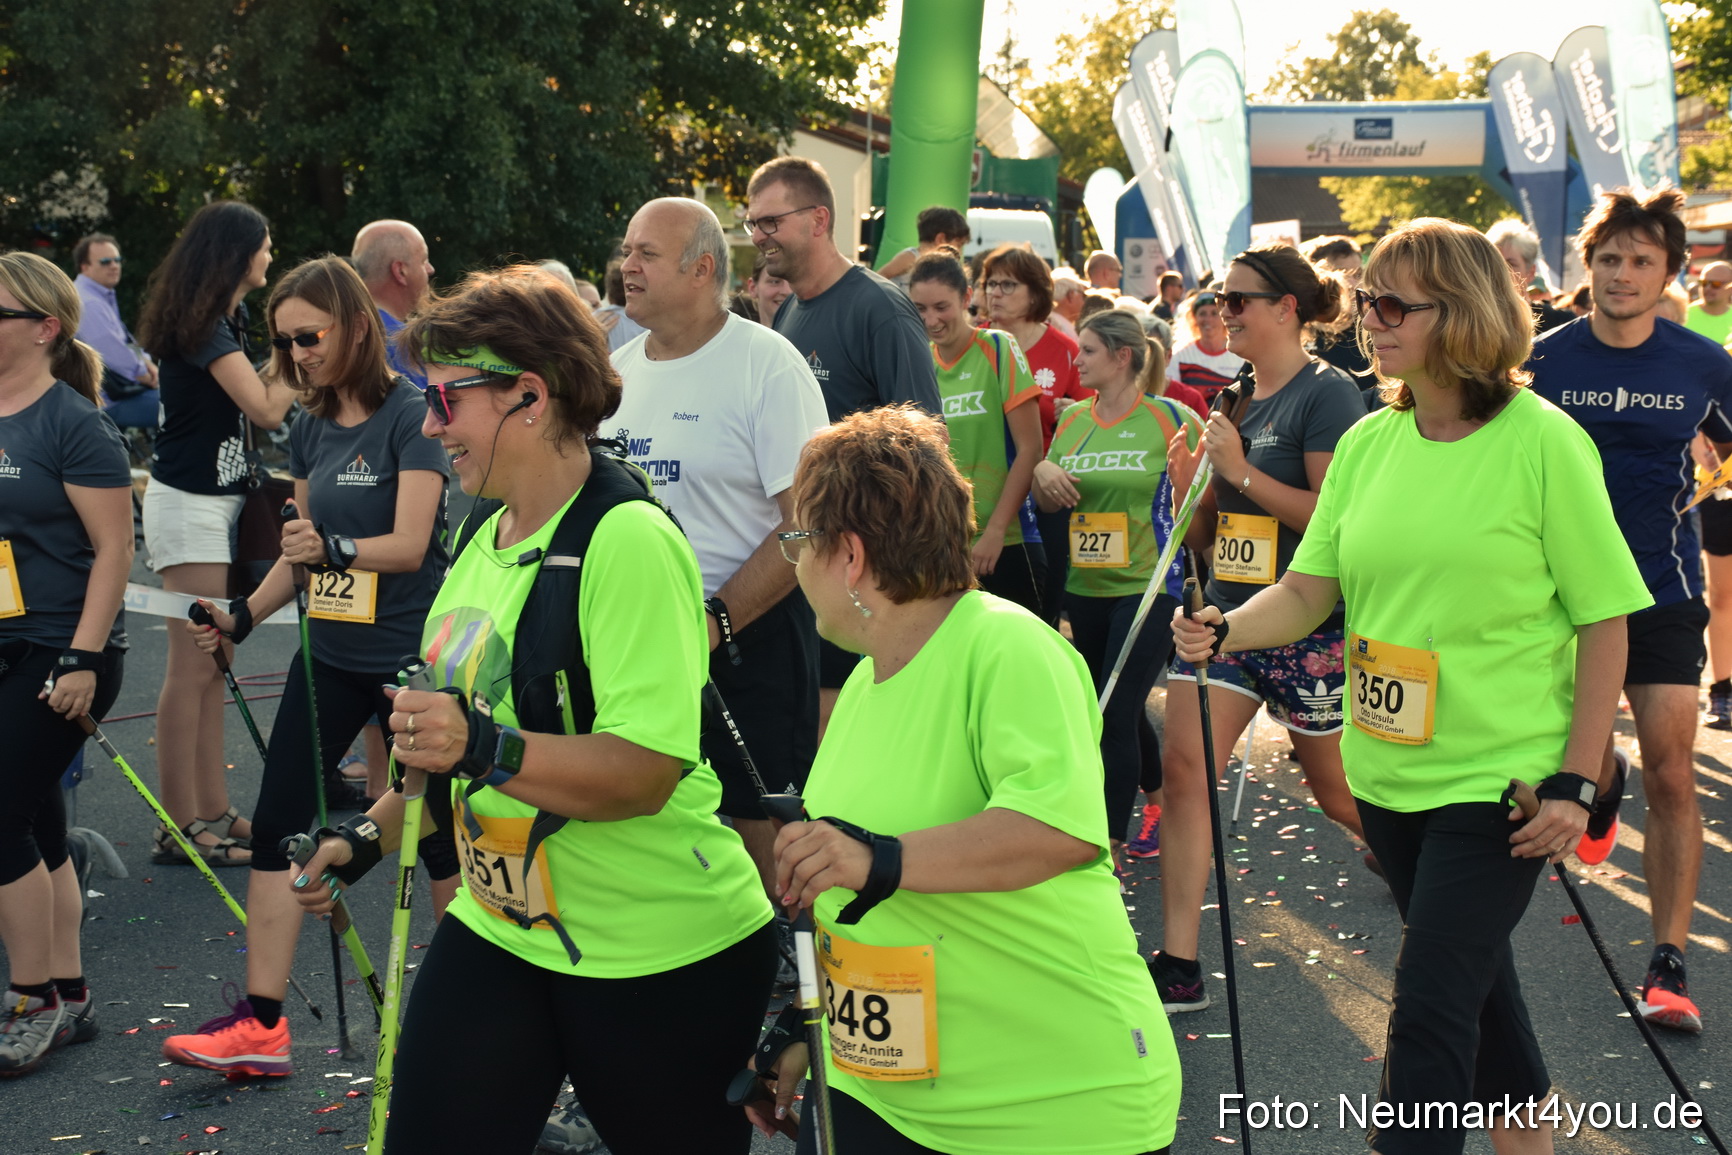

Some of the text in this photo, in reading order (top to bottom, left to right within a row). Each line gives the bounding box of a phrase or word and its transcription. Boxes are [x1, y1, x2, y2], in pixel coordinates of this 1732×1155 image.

[1338, 140, 1427, 158] firmenlauf
[1561, 390, 1685, 411] EURO POLES
[672, 412, 700, 422] Robert
[1060, 451, 1148, 474] BOCK
[337, 474, 379, 482] BURKHARDT
[1078, 532, 1111, 552] 227
[1218, 537, 1255, 564] 300
[1235, 563, 1262, 572] Stefanie
[315, 572, 355, 600] 322
[335, 599, 353, 609] Doris
[720, 612, 731, 643] LEKI
[1358, 671, 1404, 714] 350
[1297, 711, 1343, 722] adidas
[1361, 706, 1395, 725] Otto Ursula
[722, 710, 745, 746] LEKI
[1385, 725, 1404, 734] GmbH
[461, 832, 514, 894] 351
[488, 890, 526, 909] Martina
[848, 971, 874, 986] 2018
[826, 978, 892, 1042] 348
[860, 1043, 904, 1057] Annita
[869, 1056, 899, 1068] GmbH
